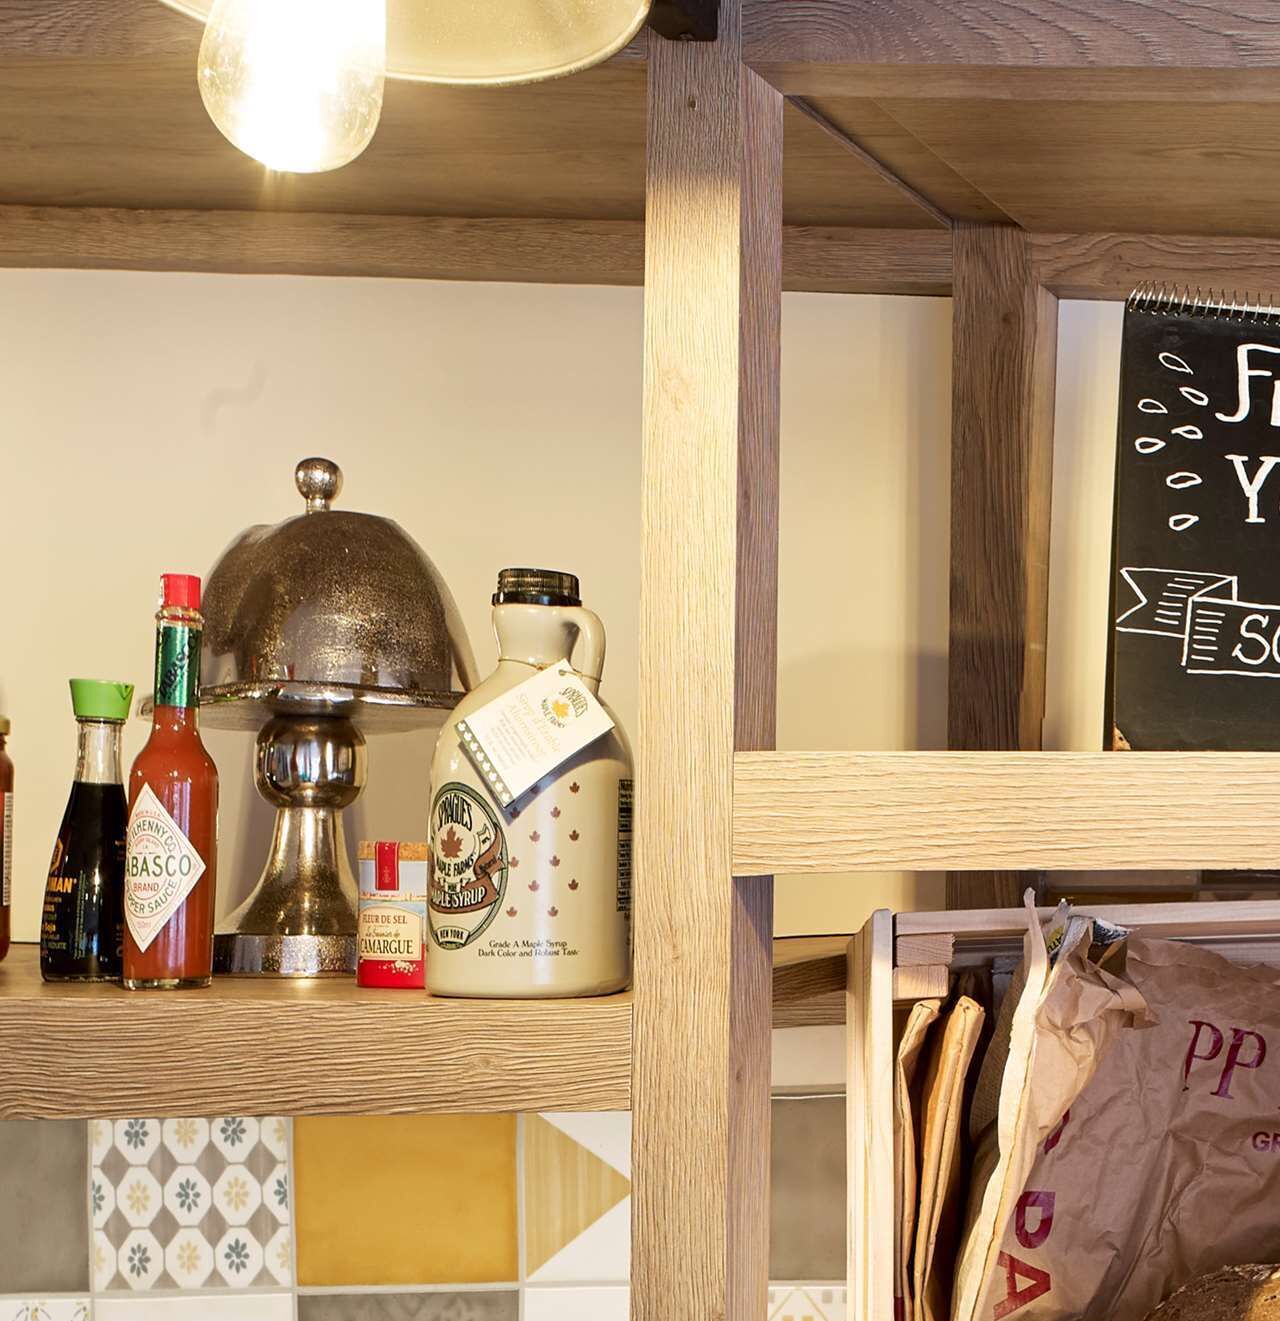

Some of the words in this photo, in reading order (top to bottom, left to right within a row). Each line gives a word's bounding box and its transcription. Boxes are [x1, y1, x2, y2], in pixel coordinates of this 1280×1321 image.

[127, 854, 191, 878] ABASCO
[133, 882, 159, 893] BRAND
[147, 880, 177, 914] SAUCE
[451, 886, 486, 909] SYRUP
[381, 914, 391, 924] DE
[361, 938, 414, 954] CAMARGUE
[489, 939, 511, 948] Grade
[513, 940, 519, 948] A
[522, 940, 544, 950] Maple
[546, 940, 568, 950] Syrup
[478, 949, 495, 957] Dark
[497, 949, 517, 957] Color
[519, 949, 532, 957] and
[534, 949, 560, 957] Robust
